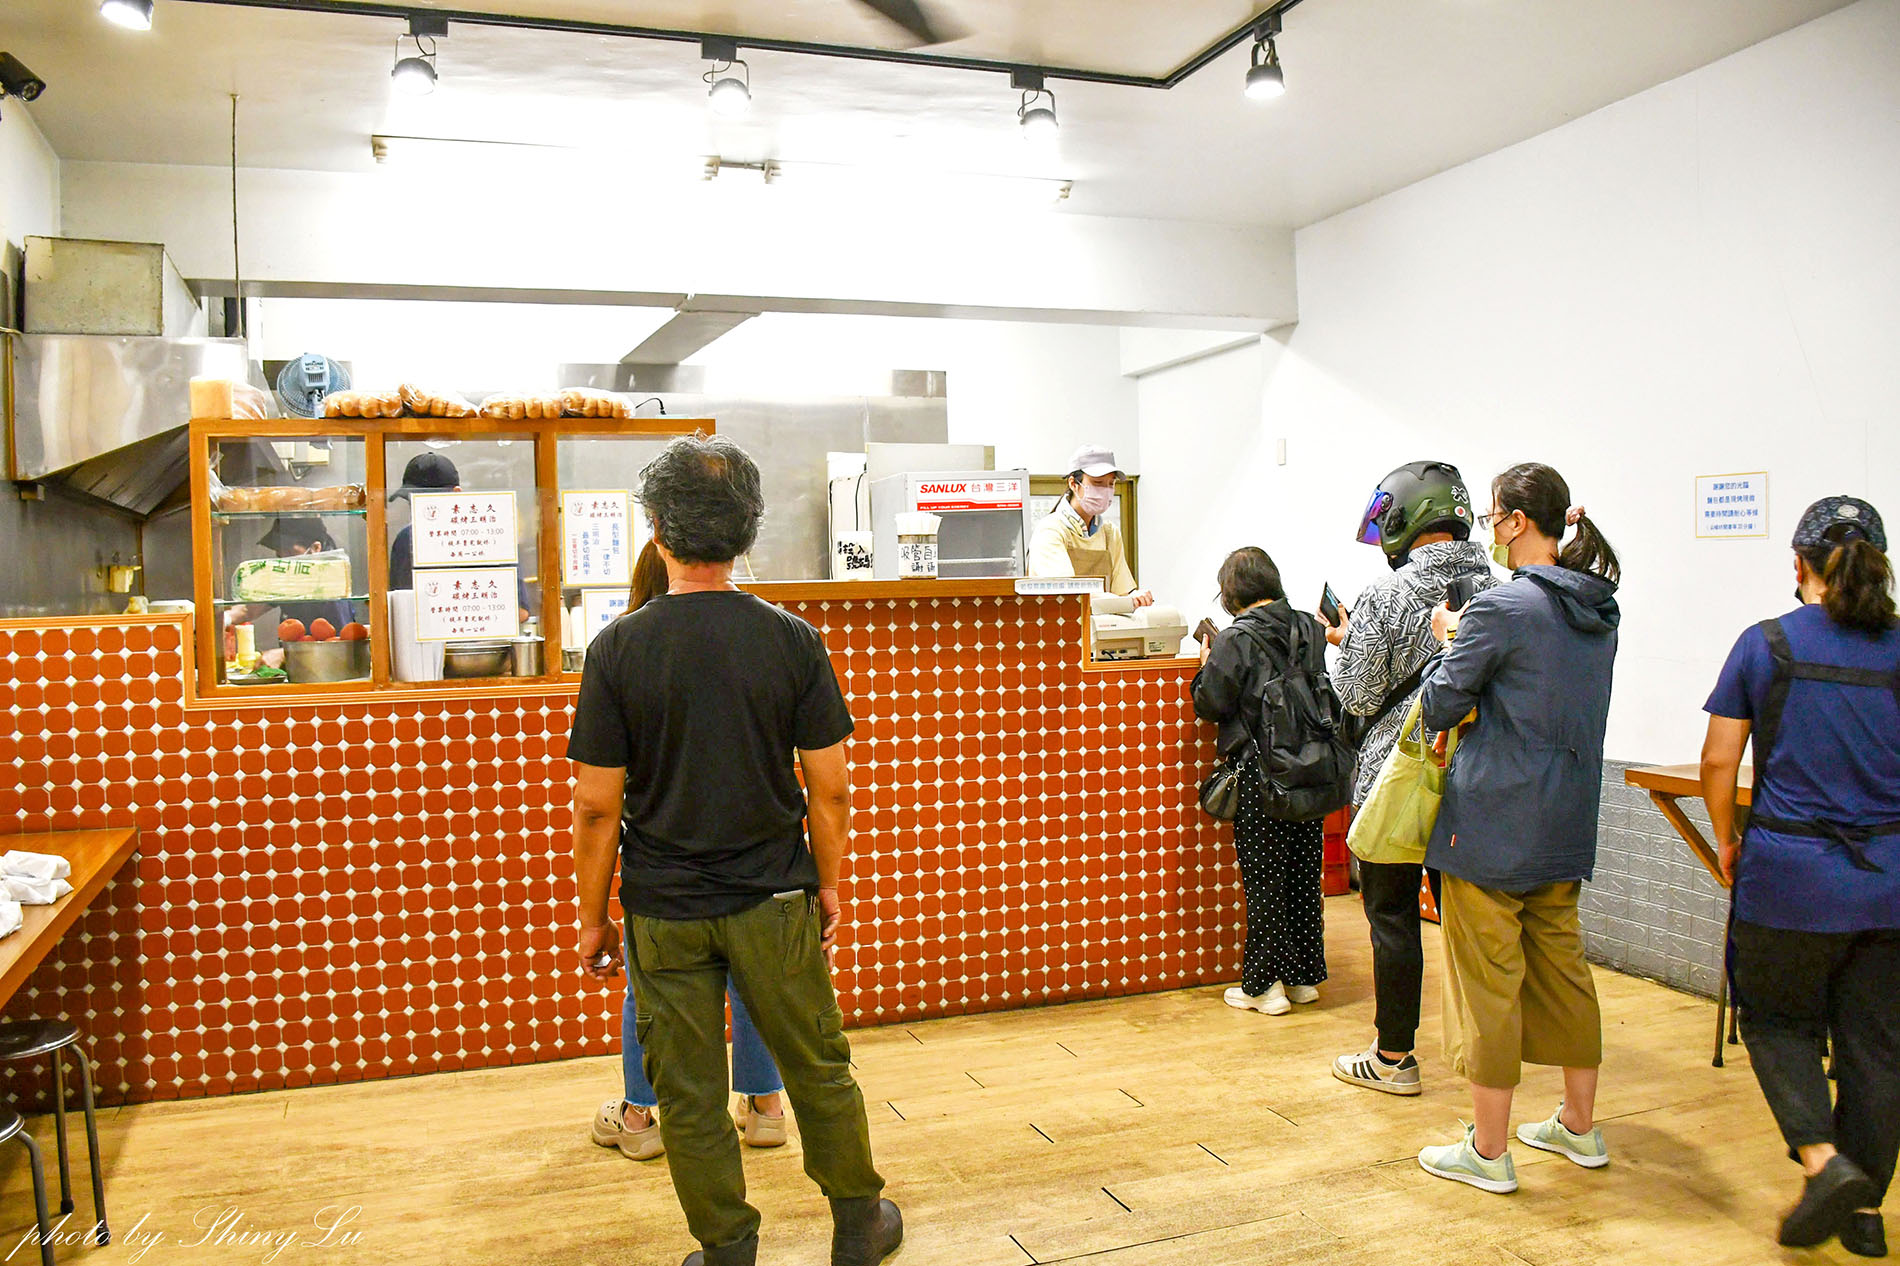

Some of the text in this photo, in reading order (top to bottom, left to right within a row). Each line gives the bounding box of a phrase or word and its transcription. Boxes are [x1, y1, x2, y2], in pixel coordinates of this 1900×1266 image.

[920, 482, 1017, 493] SANLUX 台灣三洋
[602, 548, 610, 575] 一律不切
